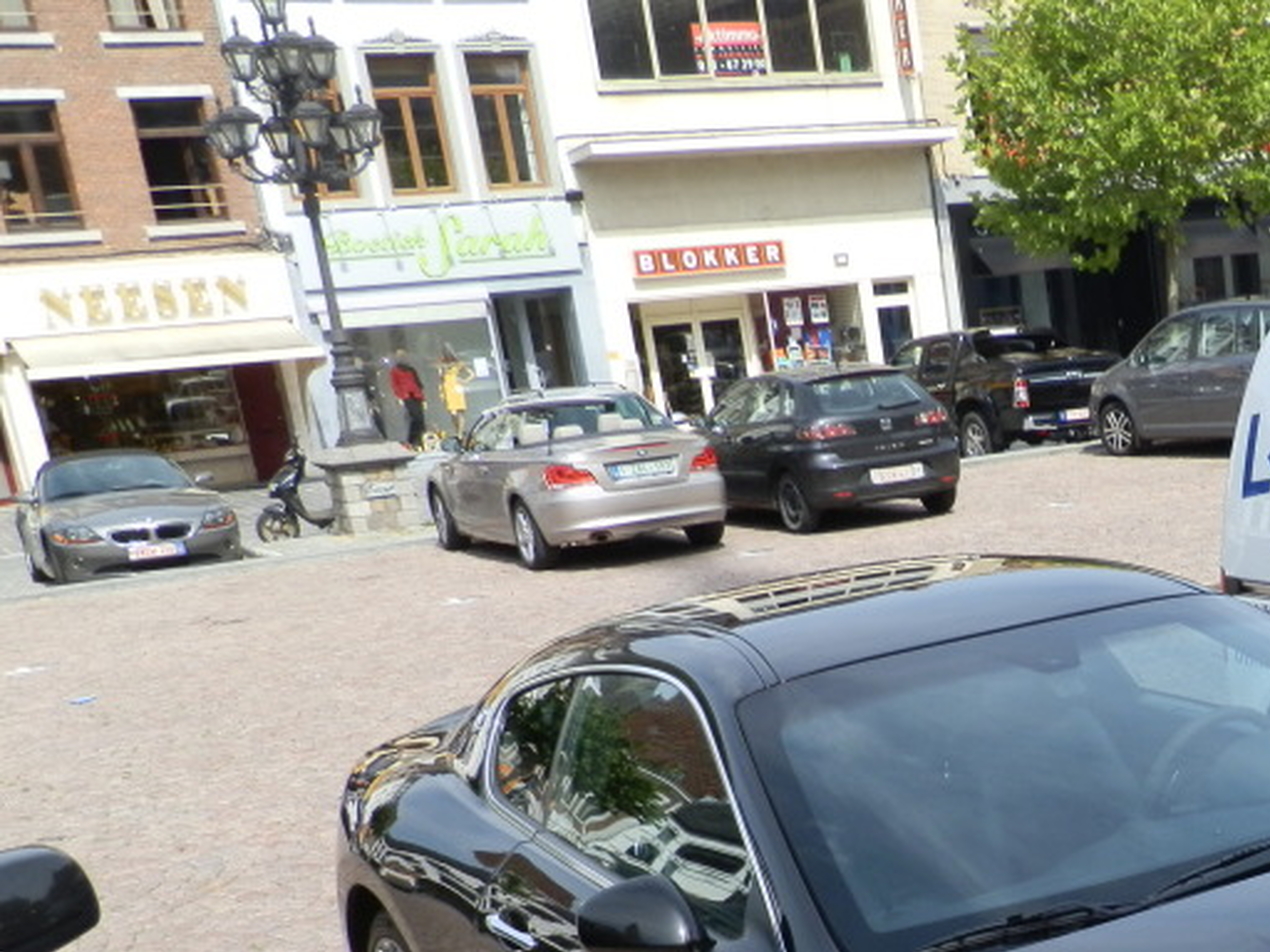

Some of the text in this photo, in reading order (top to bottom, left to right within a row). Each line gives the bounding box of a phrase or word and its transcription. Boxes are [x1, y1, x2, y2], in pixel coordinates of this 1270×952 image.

[417, 214, 550, 278] Sarah
[638, 244, 781, 272] BLOKKER
[39, 275, 248, 329] NEESEN
